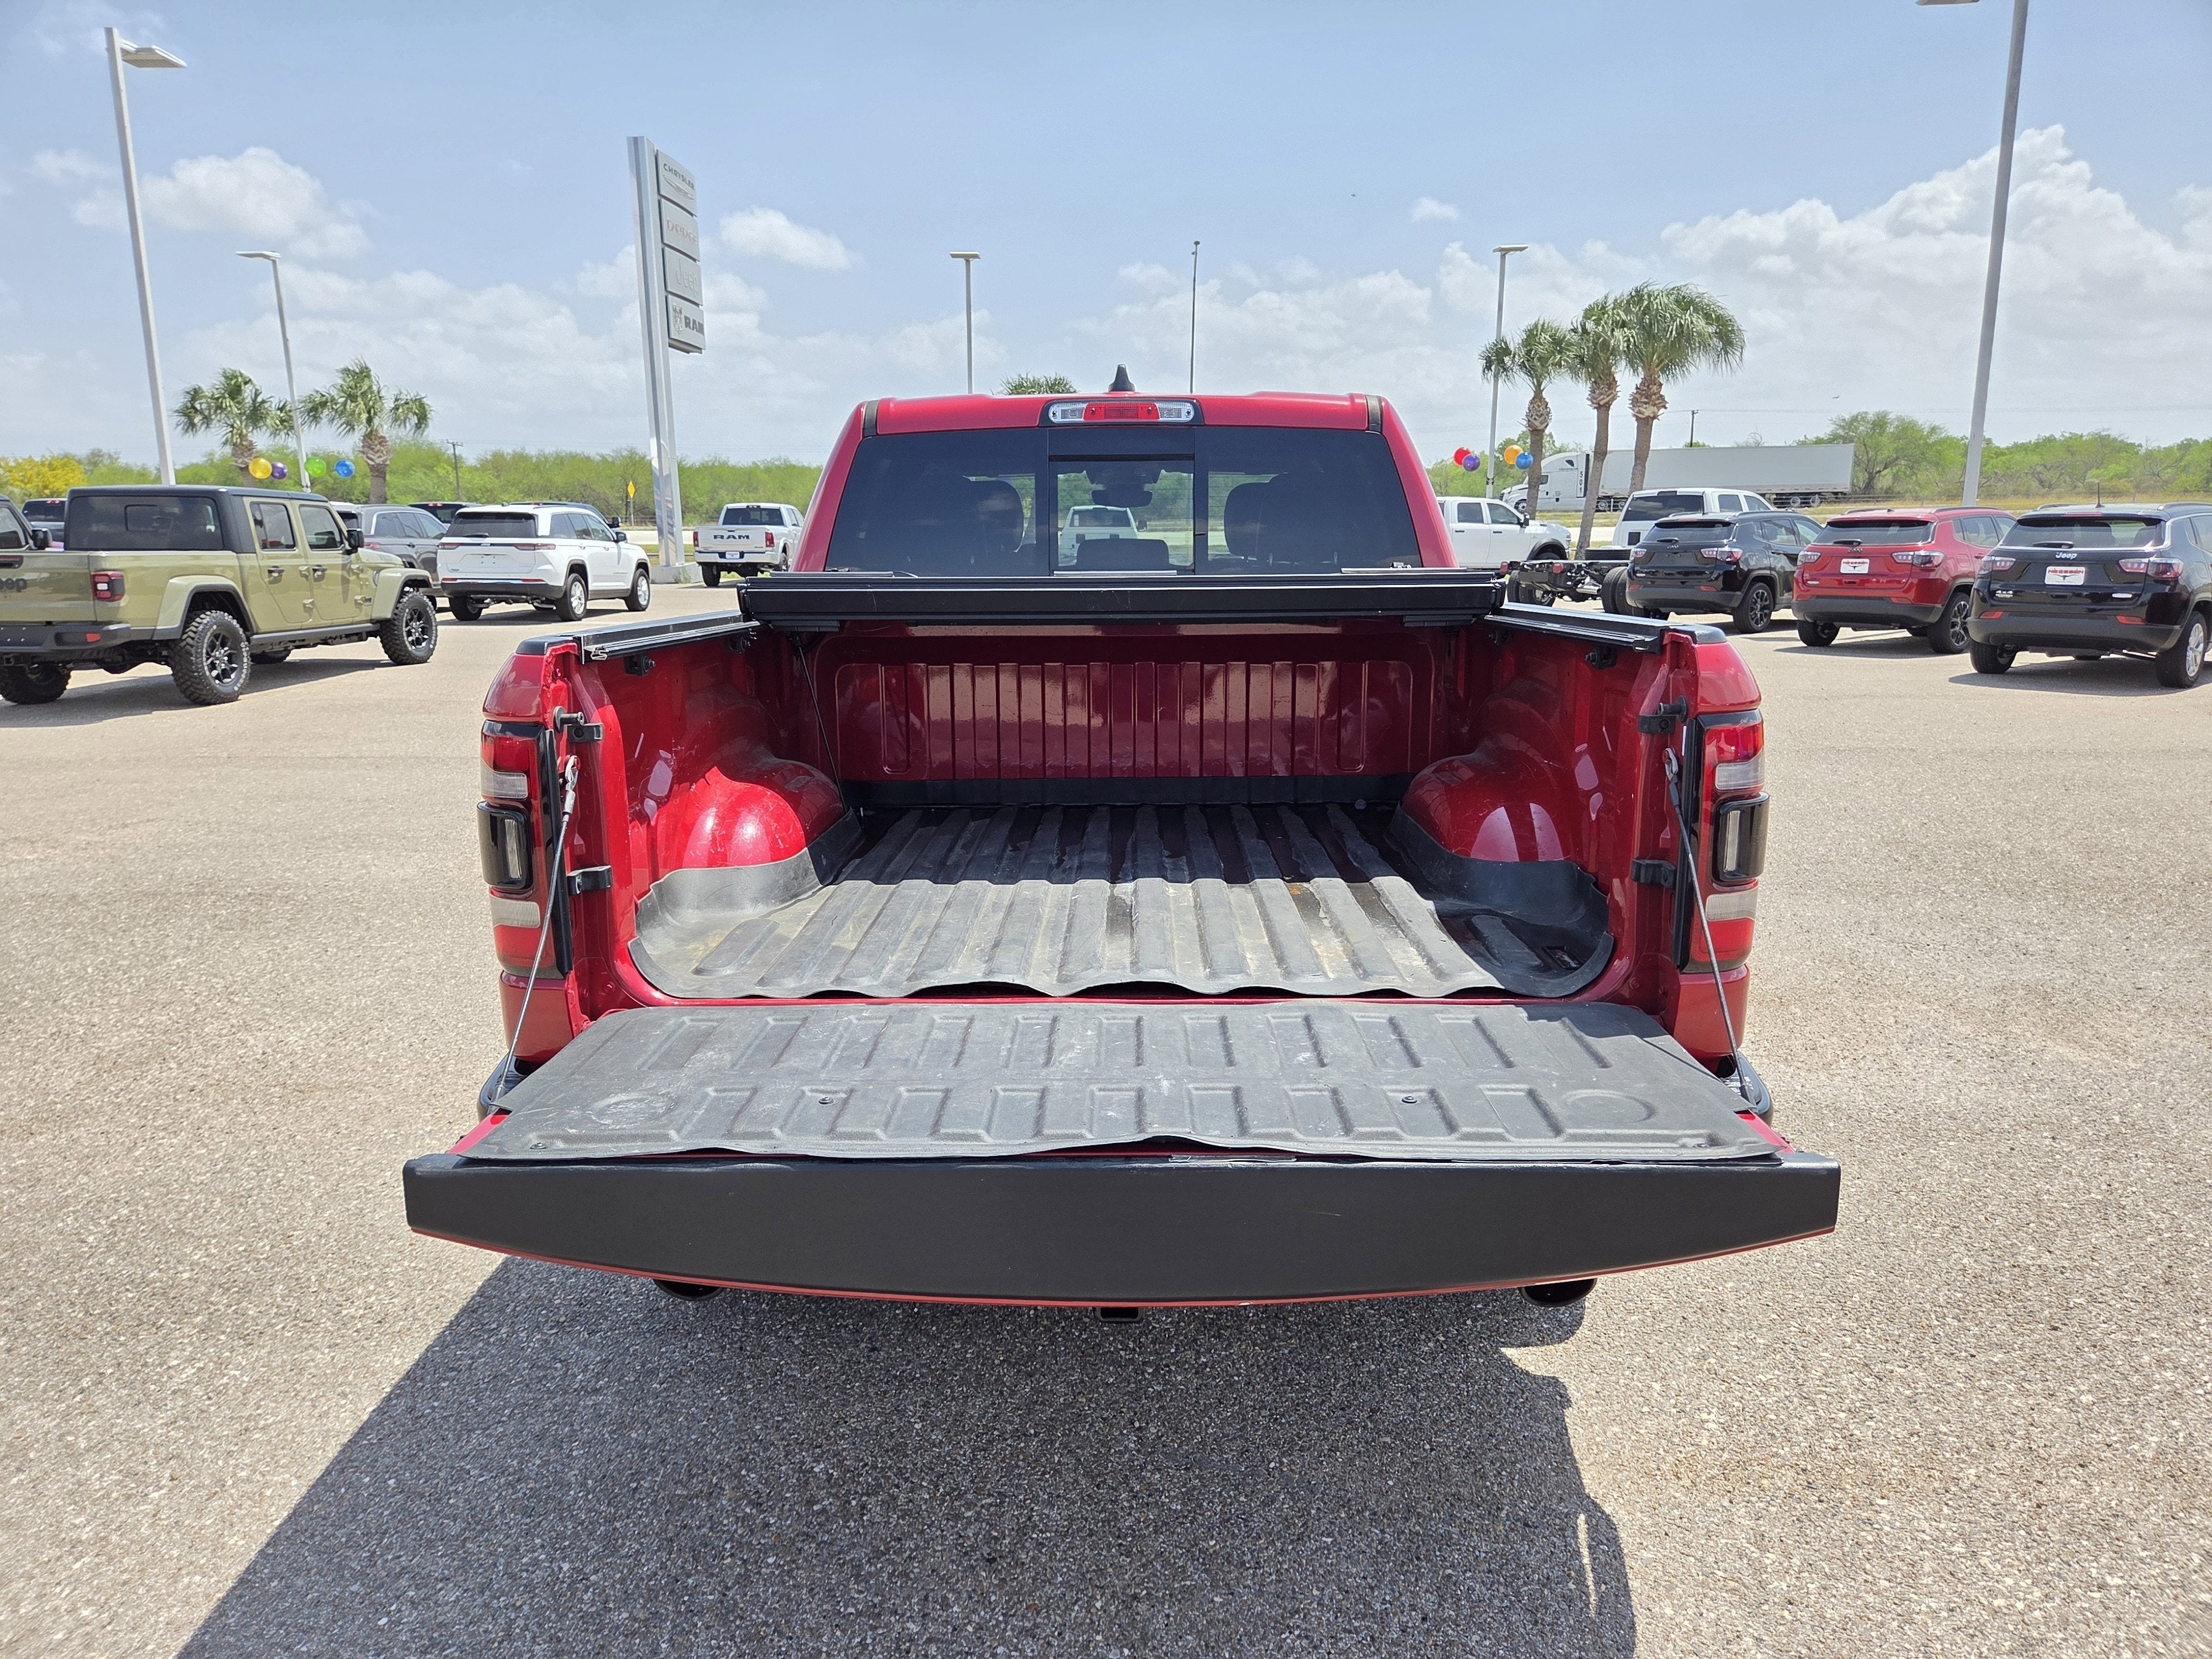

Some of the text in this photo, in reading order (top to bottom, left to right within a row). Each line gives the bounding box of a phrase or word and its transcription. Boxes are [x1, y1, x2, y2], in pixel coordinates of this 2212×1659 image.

[663, 163, 695, 191] CHRYSLER
[666, 219, 697, 244] DODGE
[675, 258, 698, 298] Jeep
